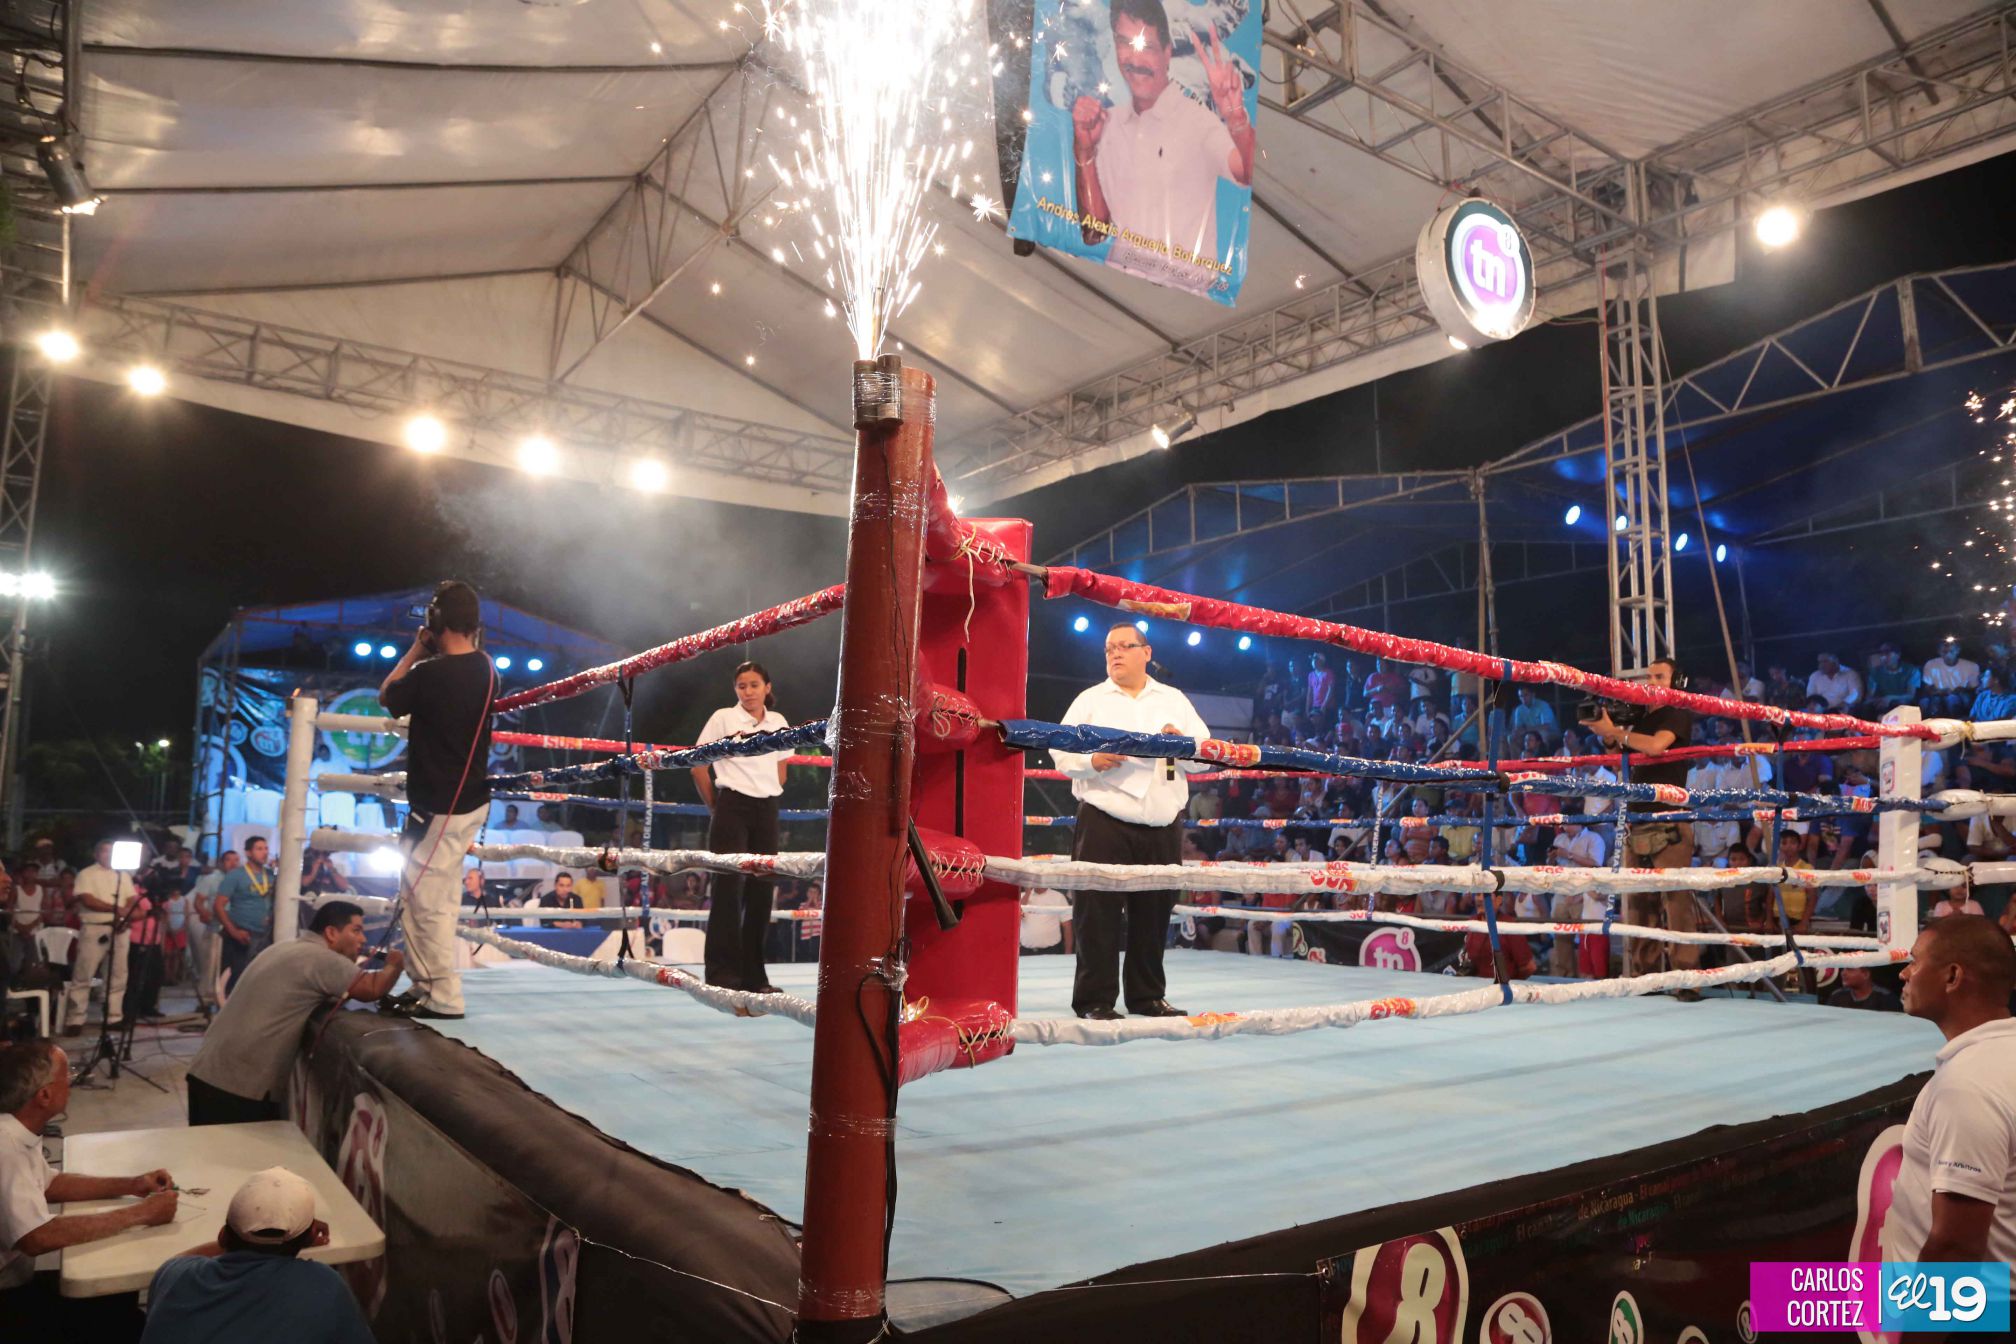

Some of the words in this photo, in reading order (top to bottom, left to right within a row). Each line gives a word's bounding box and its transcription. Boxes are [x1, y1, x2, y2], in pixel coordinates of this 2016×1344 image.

[1036, 196, 1080, 225] Andres
[1081, 213, 1118, 237] Alexis
[1470, 239, 1506, 298] tn
[1401, 931, 1409, 945] 8
[1590, 1191, 1634, 1217] Nicaragua
